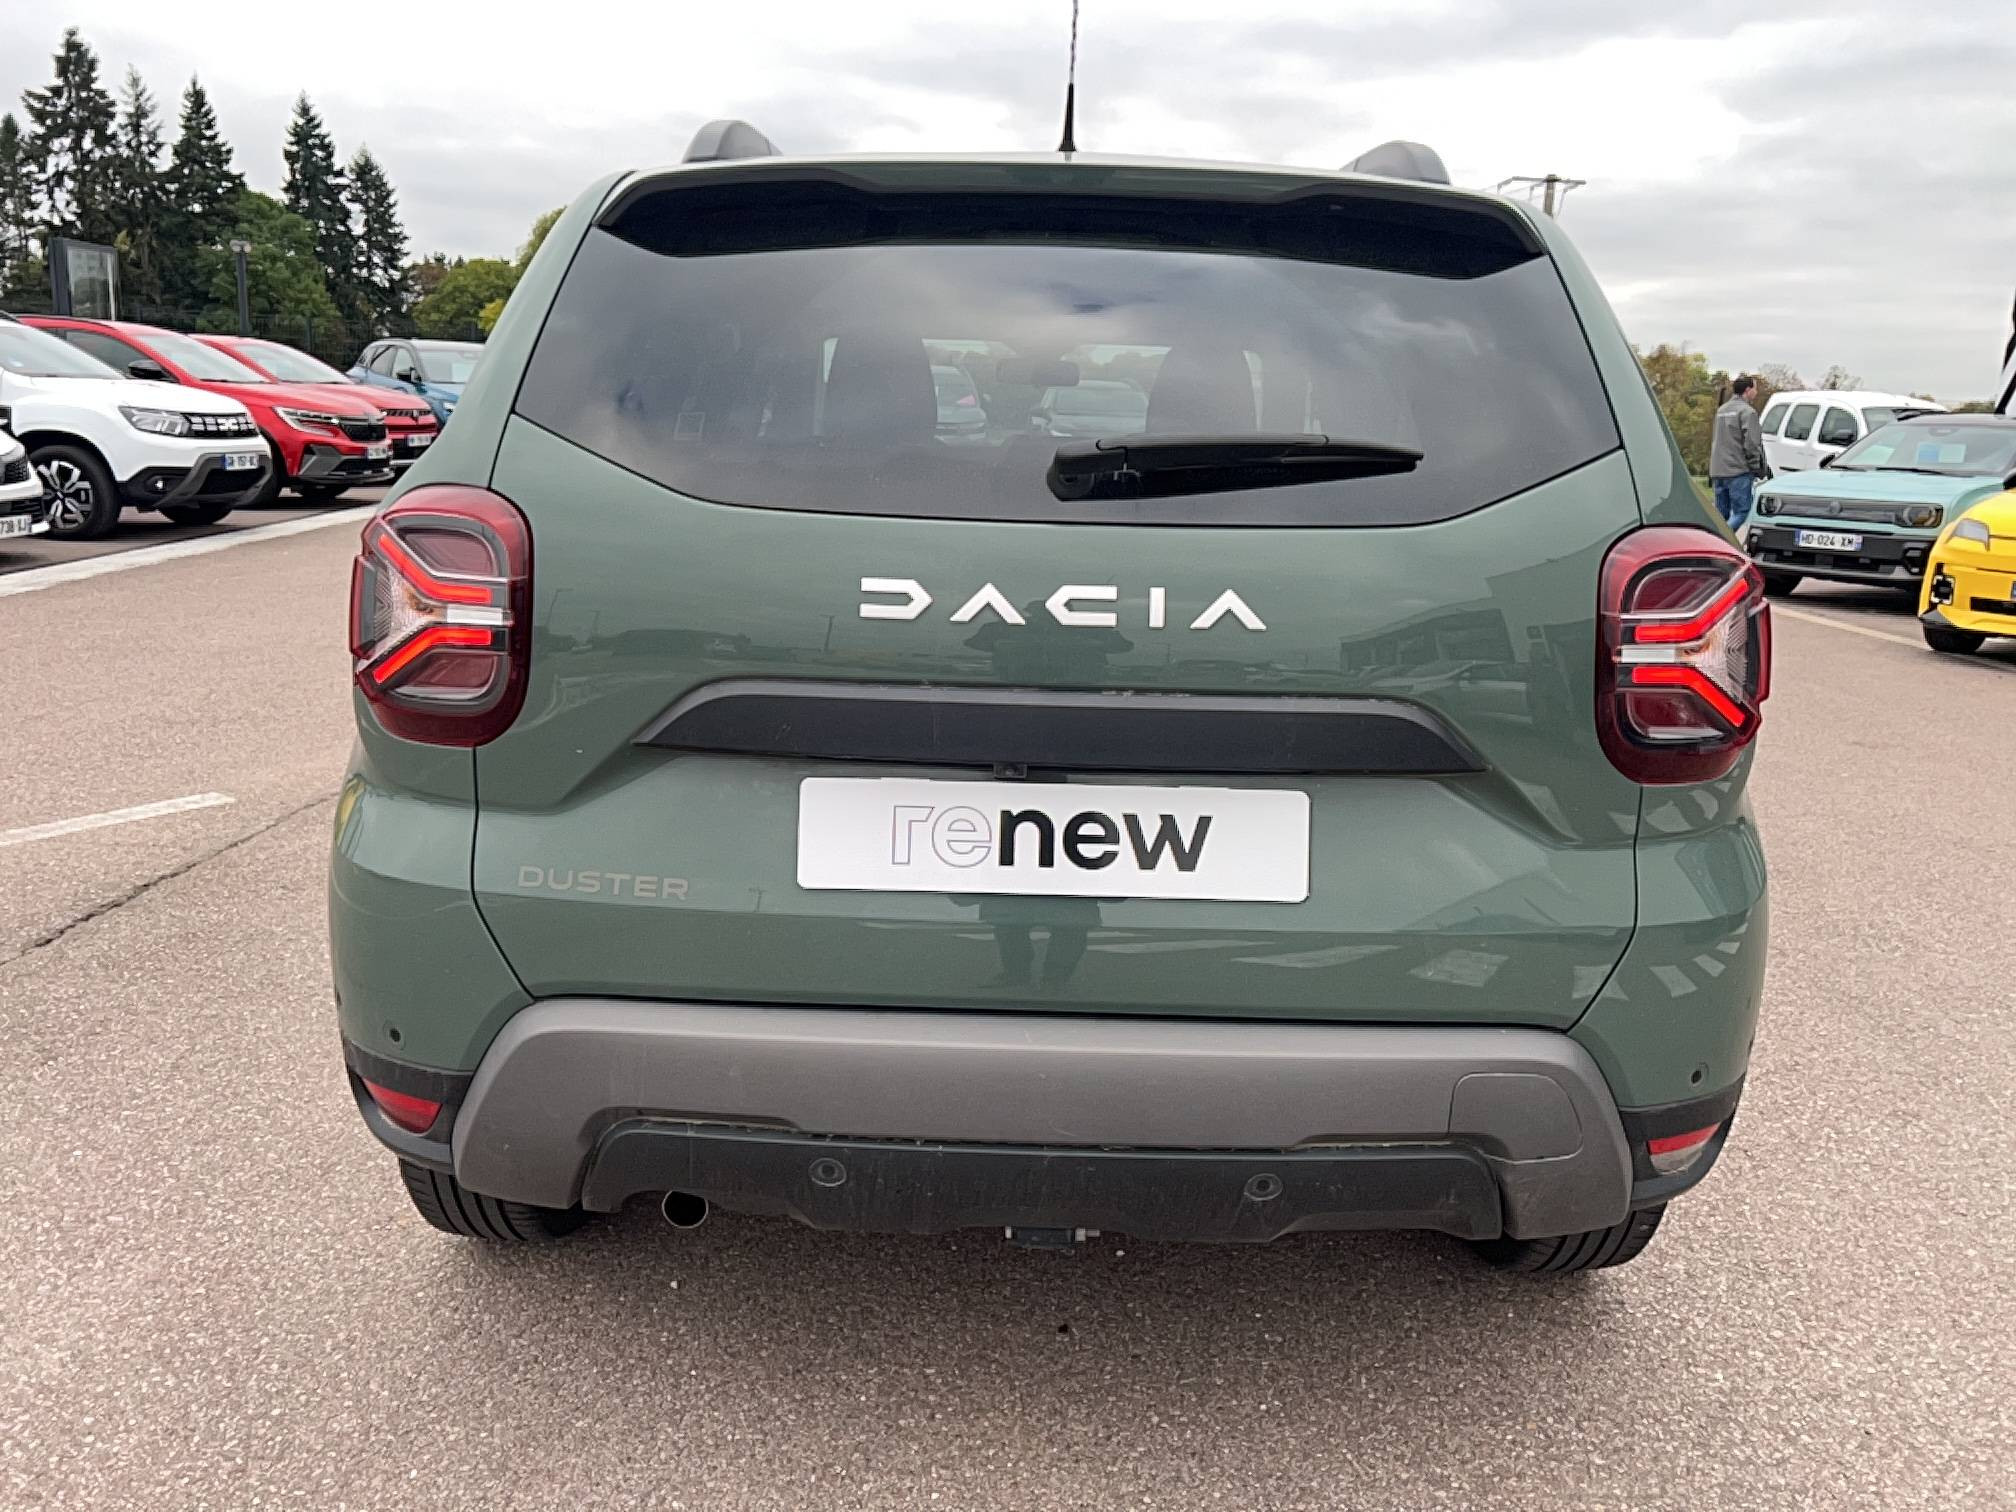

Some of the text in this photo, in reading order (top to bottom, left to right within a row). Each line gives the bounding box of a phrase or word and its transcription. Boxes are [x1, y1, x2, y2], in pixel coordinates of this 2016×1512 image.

[858, 576, 1267, 631] DACIA
[891, 804, 1213, 872] renew
[517, 865, 689, 901] DUSTER
